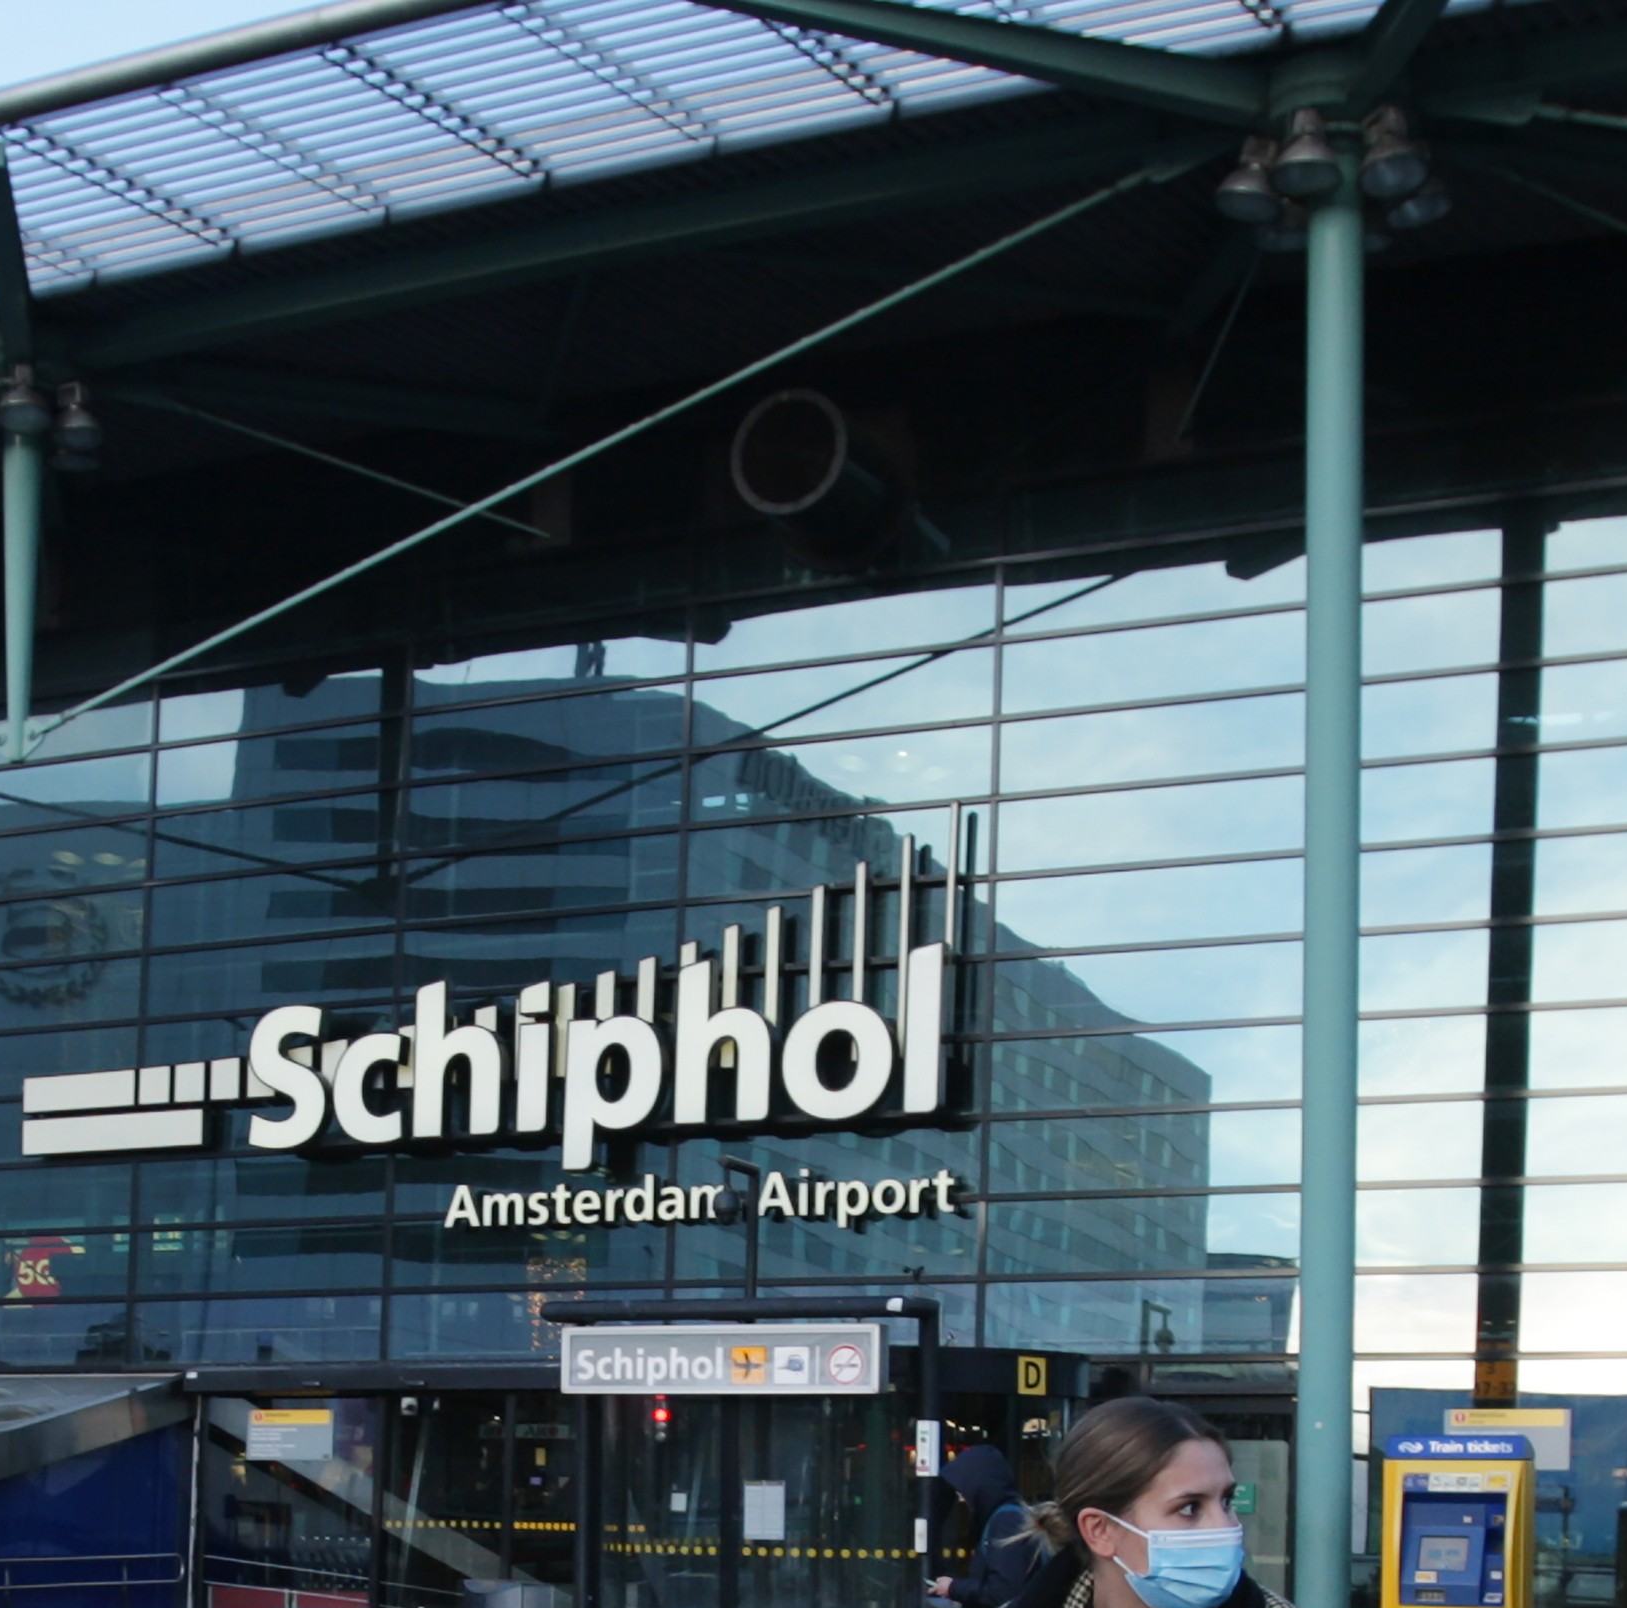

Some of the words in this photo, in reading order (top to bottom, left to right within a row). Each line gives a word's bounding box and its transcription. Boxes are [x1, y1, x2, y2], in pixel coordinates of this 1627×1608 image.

[248, 942, 944, 1170] Schiphol
[443, 1174, 727, 1229] Amsterdam
[758, 1168, 956, 1228] Airport
[576, 1346, 724, 1387] Schiphol
[1025, 1361, 1041, 1389] D
[1429, 1440, 1464, 1454] Train
[1467, 1440, 1513, 1454] tickets
